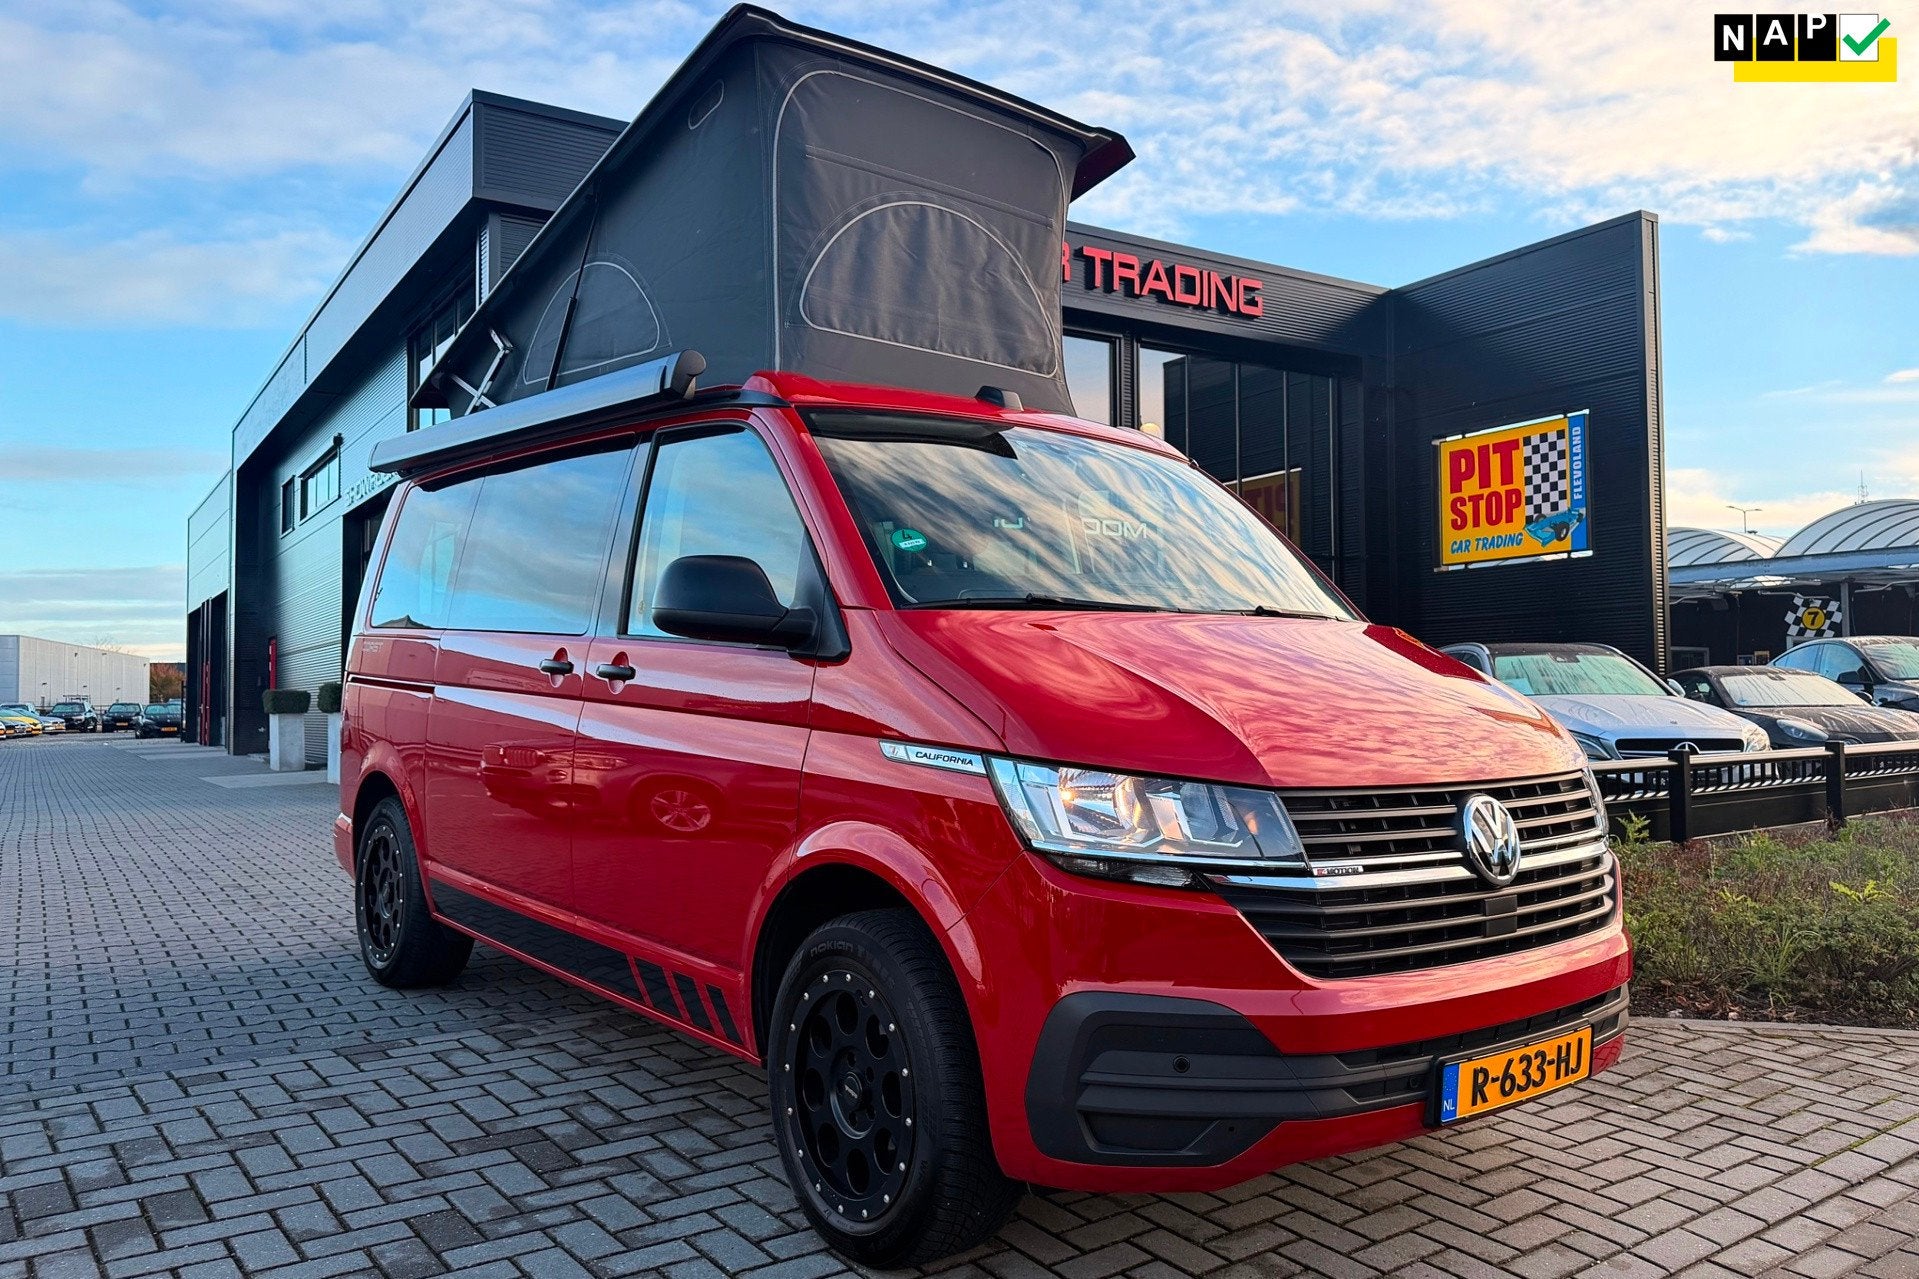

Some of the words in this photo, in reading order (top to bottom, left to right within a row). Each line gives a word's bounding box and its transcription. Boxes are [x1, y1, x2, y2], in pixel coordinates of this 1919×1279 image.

[1081, 245, 1264, 318] TRADING
[1449, 438, 1520, 494] PIT
[1572, 426, 1583, 501] FLEVOLAND
[1450, 488, 1522, 531] STOP
[1451, 539, 1471, 554] CAR
[1475, 532, 1524, 551] TRADING
[1808, 611, 1819, 626] 7
[915, 751, 974, 766] CALIFORNIA
[1471, 1037, 1584, 1107] R-633-HJ
[1442, 1099, 1456, 1112] NL
